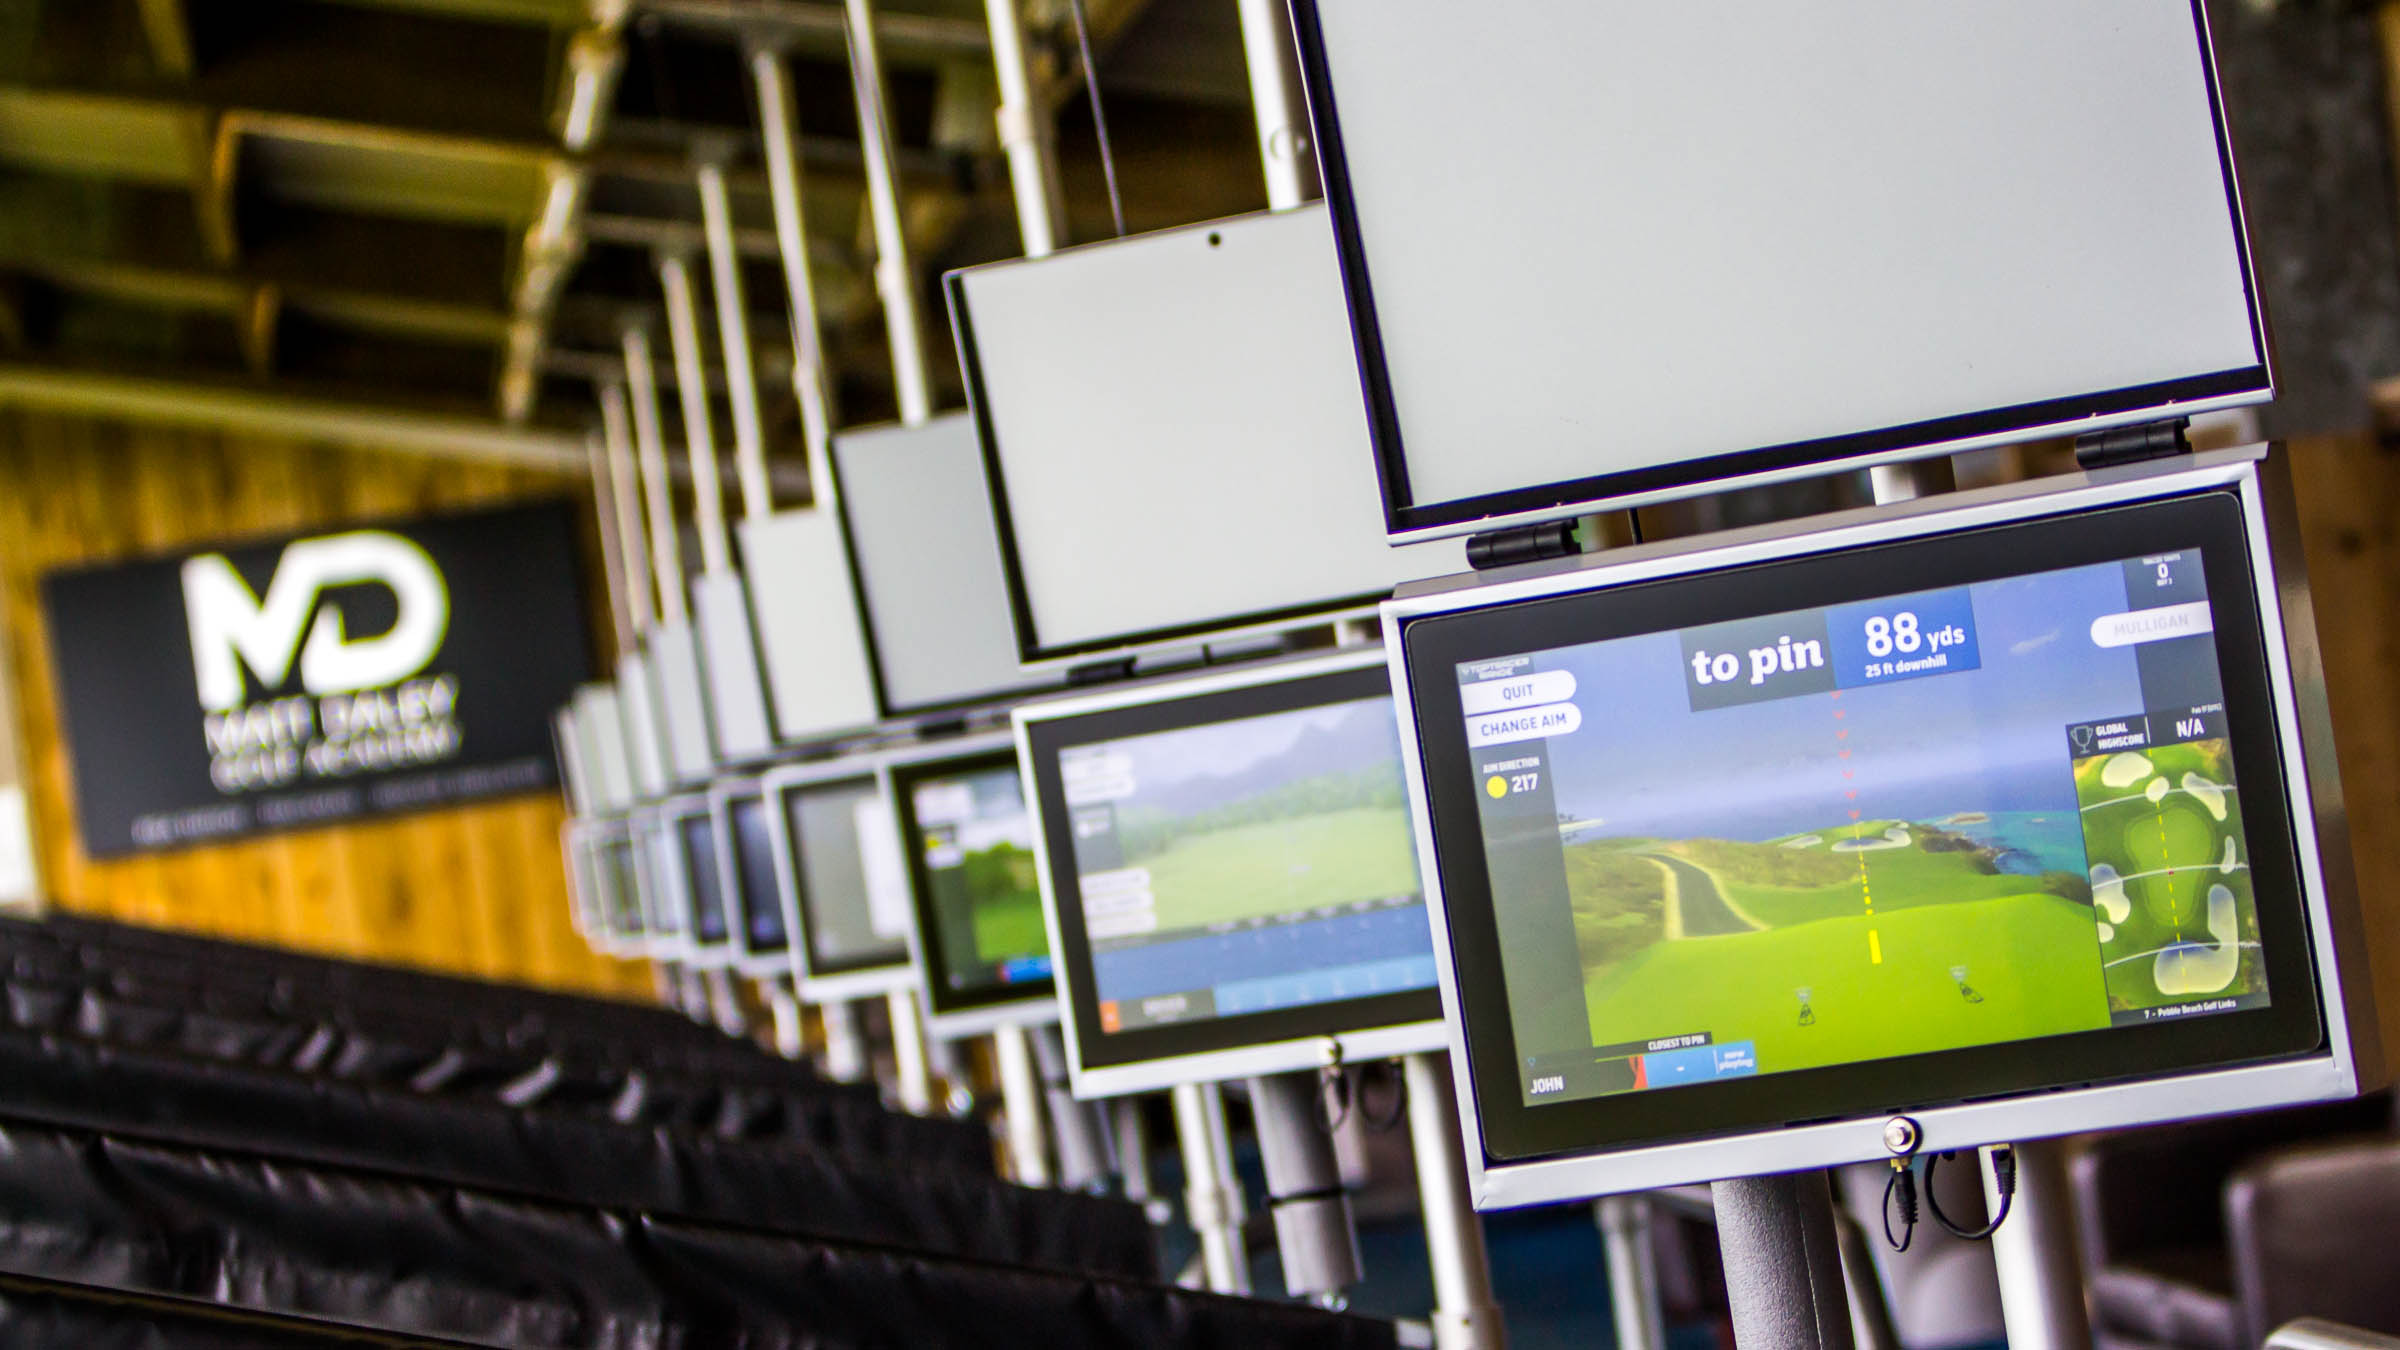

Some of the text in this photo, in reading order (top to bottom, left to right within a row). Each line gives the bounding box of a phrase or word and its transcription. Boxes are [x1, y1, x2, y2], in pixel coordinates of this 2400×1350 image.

[2157, 563, 2168, 578] 0
[181, 530, 450, 711] MD
[2114, 614, 2189, 636] MULLIGAN
[1864, 611, 1966, 657] 88 yds
[1692, 635, 1824, 685] to pin
[1865, 653, 1947, 678] 25 ft downhill
[1502, 684, 1533, 700] QUIT
[1481, 713, 1567, 736] CHANGE AIM
[2095, 717, 2204, 738] GLOBAL N/A
[2098, 733, 2145, 750] HIGHSCORE
[1512, 773, 1538, 792] 217
[1648, 1034, 1705, 1051] CLOSEST TO PIN
[1531, 1076, 1564, 1094] JOHN
